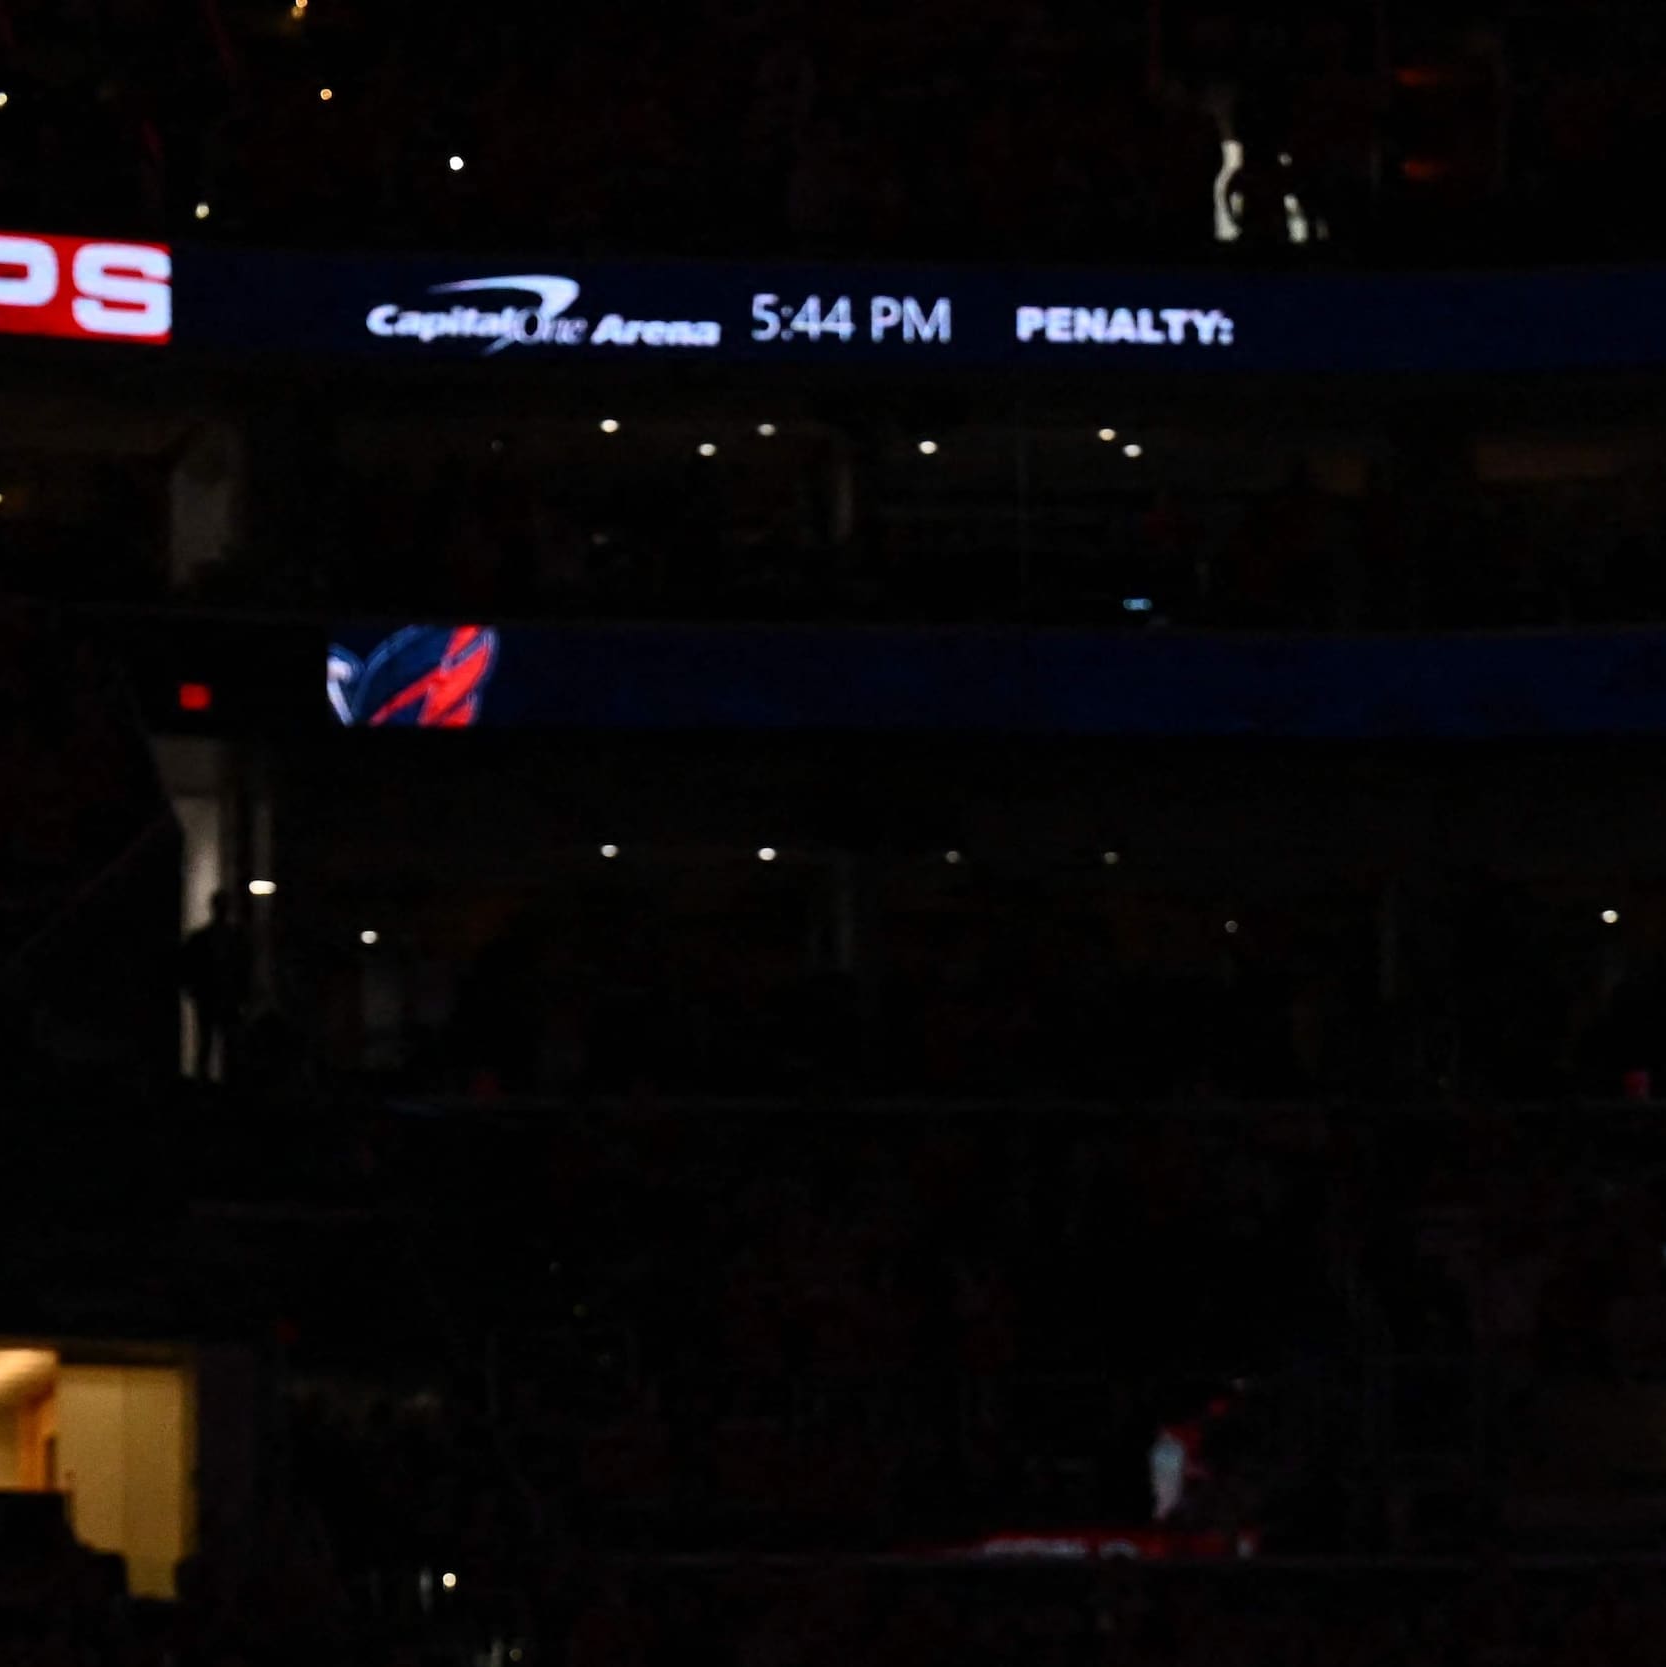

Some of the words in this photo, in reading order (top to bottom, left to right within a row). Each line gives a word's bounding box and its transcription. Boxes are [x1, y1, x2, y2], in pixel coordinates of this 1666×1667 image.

[590, 313, 722, 347] Arena
[751, 293, 855, 342] 5:44
[871, 296, 951, 343] PM
[1016, 306, 1234, 345] PENALTY:
